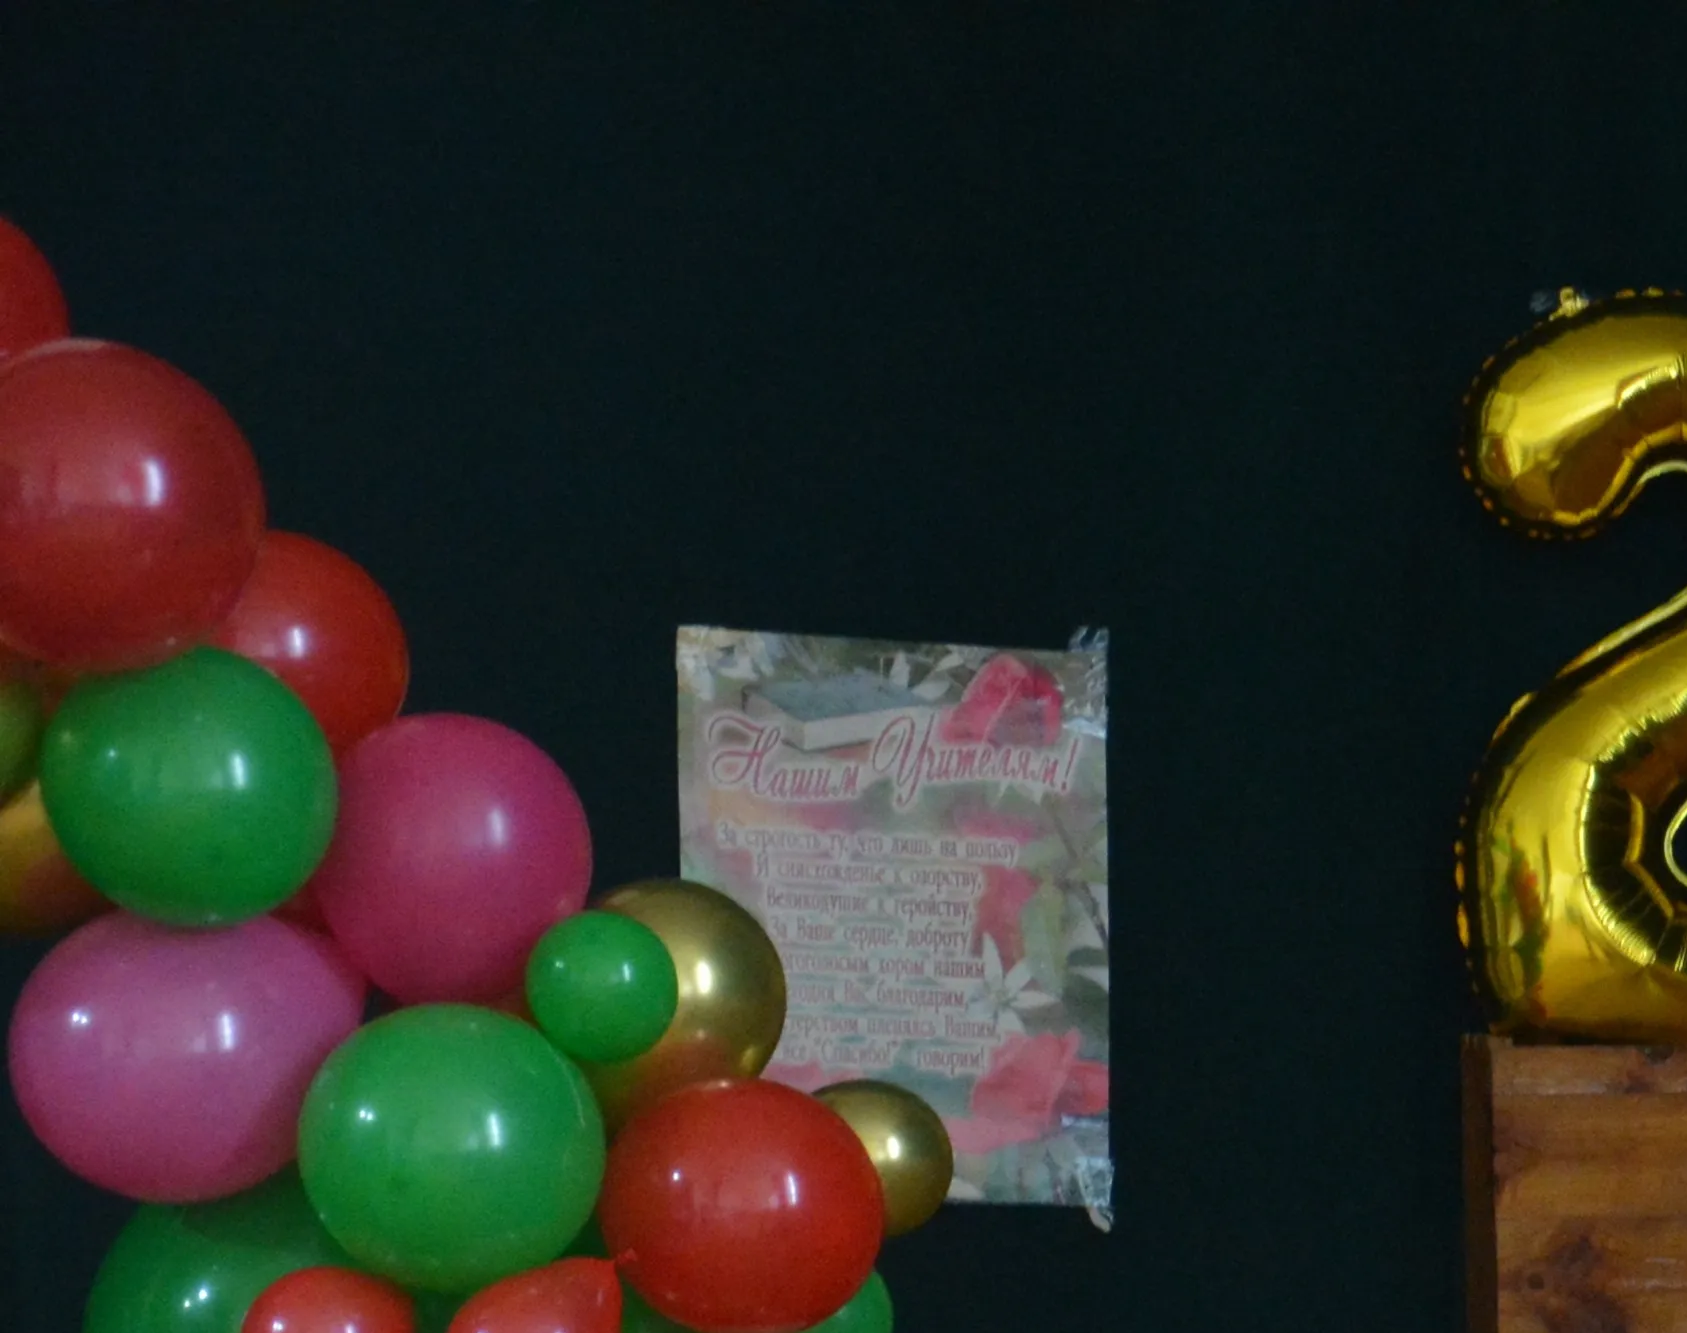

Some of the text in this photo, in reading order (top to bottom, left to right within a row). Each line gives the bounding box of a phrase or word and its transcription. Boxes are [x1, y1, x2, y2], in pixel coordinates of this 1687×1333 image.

[708, 712, 1080, 807] Нашим Учителям!
[719, 821, 737, 847] За
[745, 829, 821, 853] строгость
[892, 837, 932, 855] лишь
[940, 839, 958, 857] на
[965, 841, 1017, 869] пользу
[893, 869, 904, 884] к
[877, 896, 886, 912] к
[894, 893, 973, 926] геройству,
[770, 915, 788, 940] За
[843, 923, 901, 954] сердце,
[906, 922, 969, 957] доброту
[879, 957, 925, 982] хором
[933, 959, 986, 979] нашим
[876, 977, 970, 1014] благодарим,
[944, 1014, 1001, 1042] Вашим,
[915, 1046, 986, 1076] говорим!
